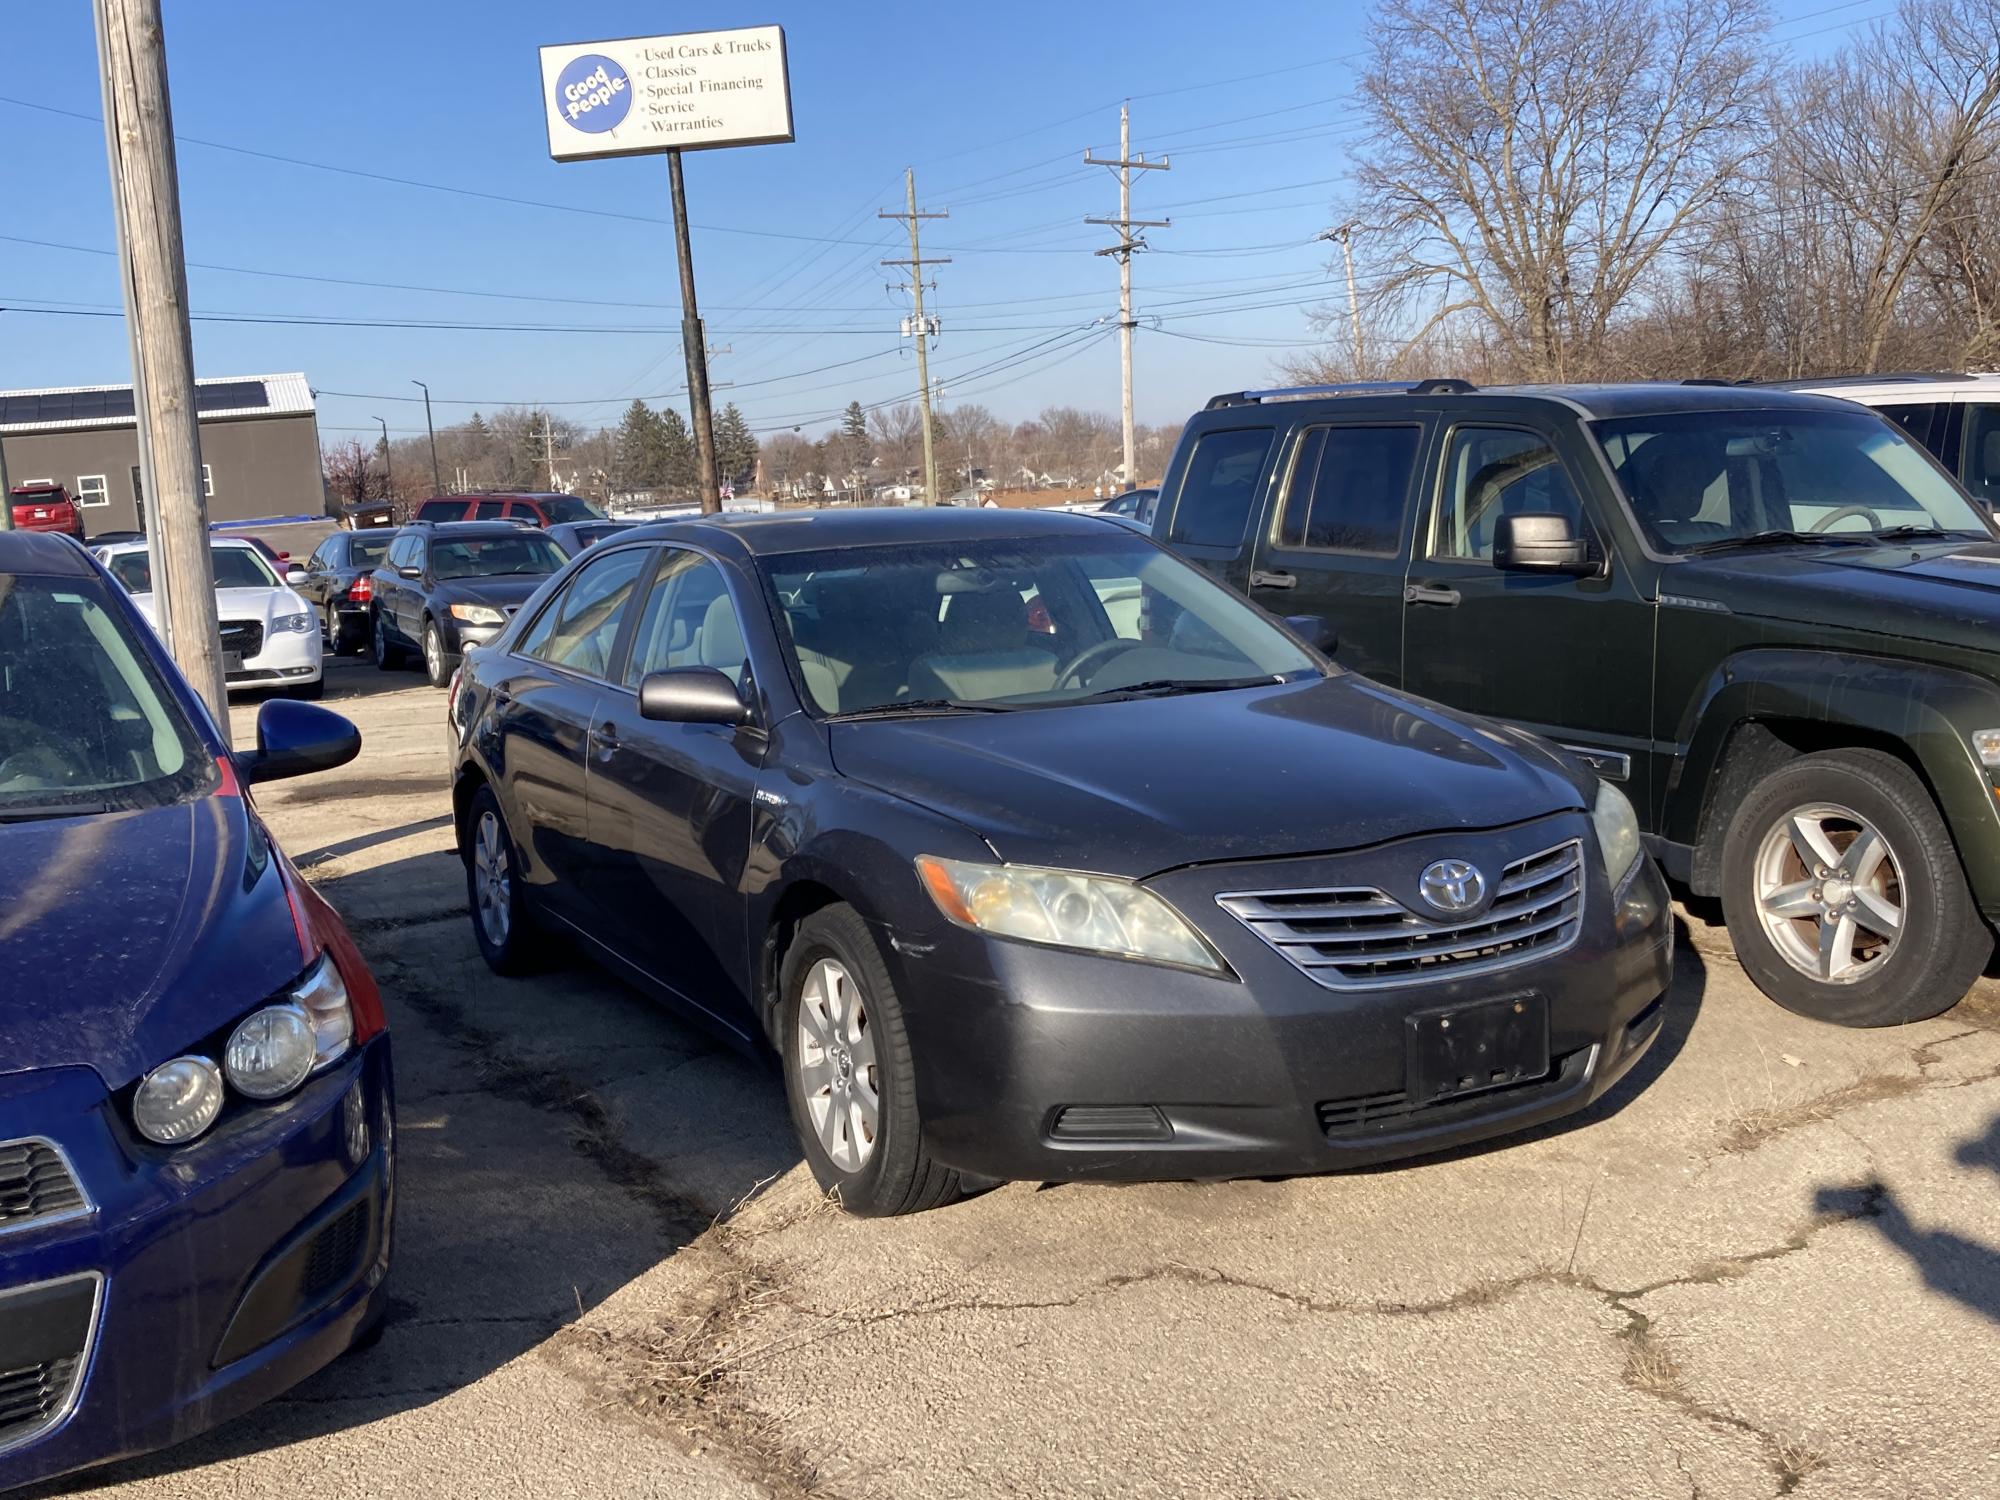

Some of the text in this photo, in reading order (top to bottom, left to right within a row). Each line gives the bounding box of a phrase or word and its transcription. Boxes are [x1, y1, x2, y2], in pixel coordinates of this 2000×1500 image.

[644, 39, 771, 61] Used Cars & Trucks
[645, 64, 697, 79] Classics
[565, 65, 608, 101] Good
[647, 76, 763, 99] Special Financing
[566, 78, 625, 120] People
[648, 100, 695, 115] Service
[651, 115, 724, 132] Warranties
